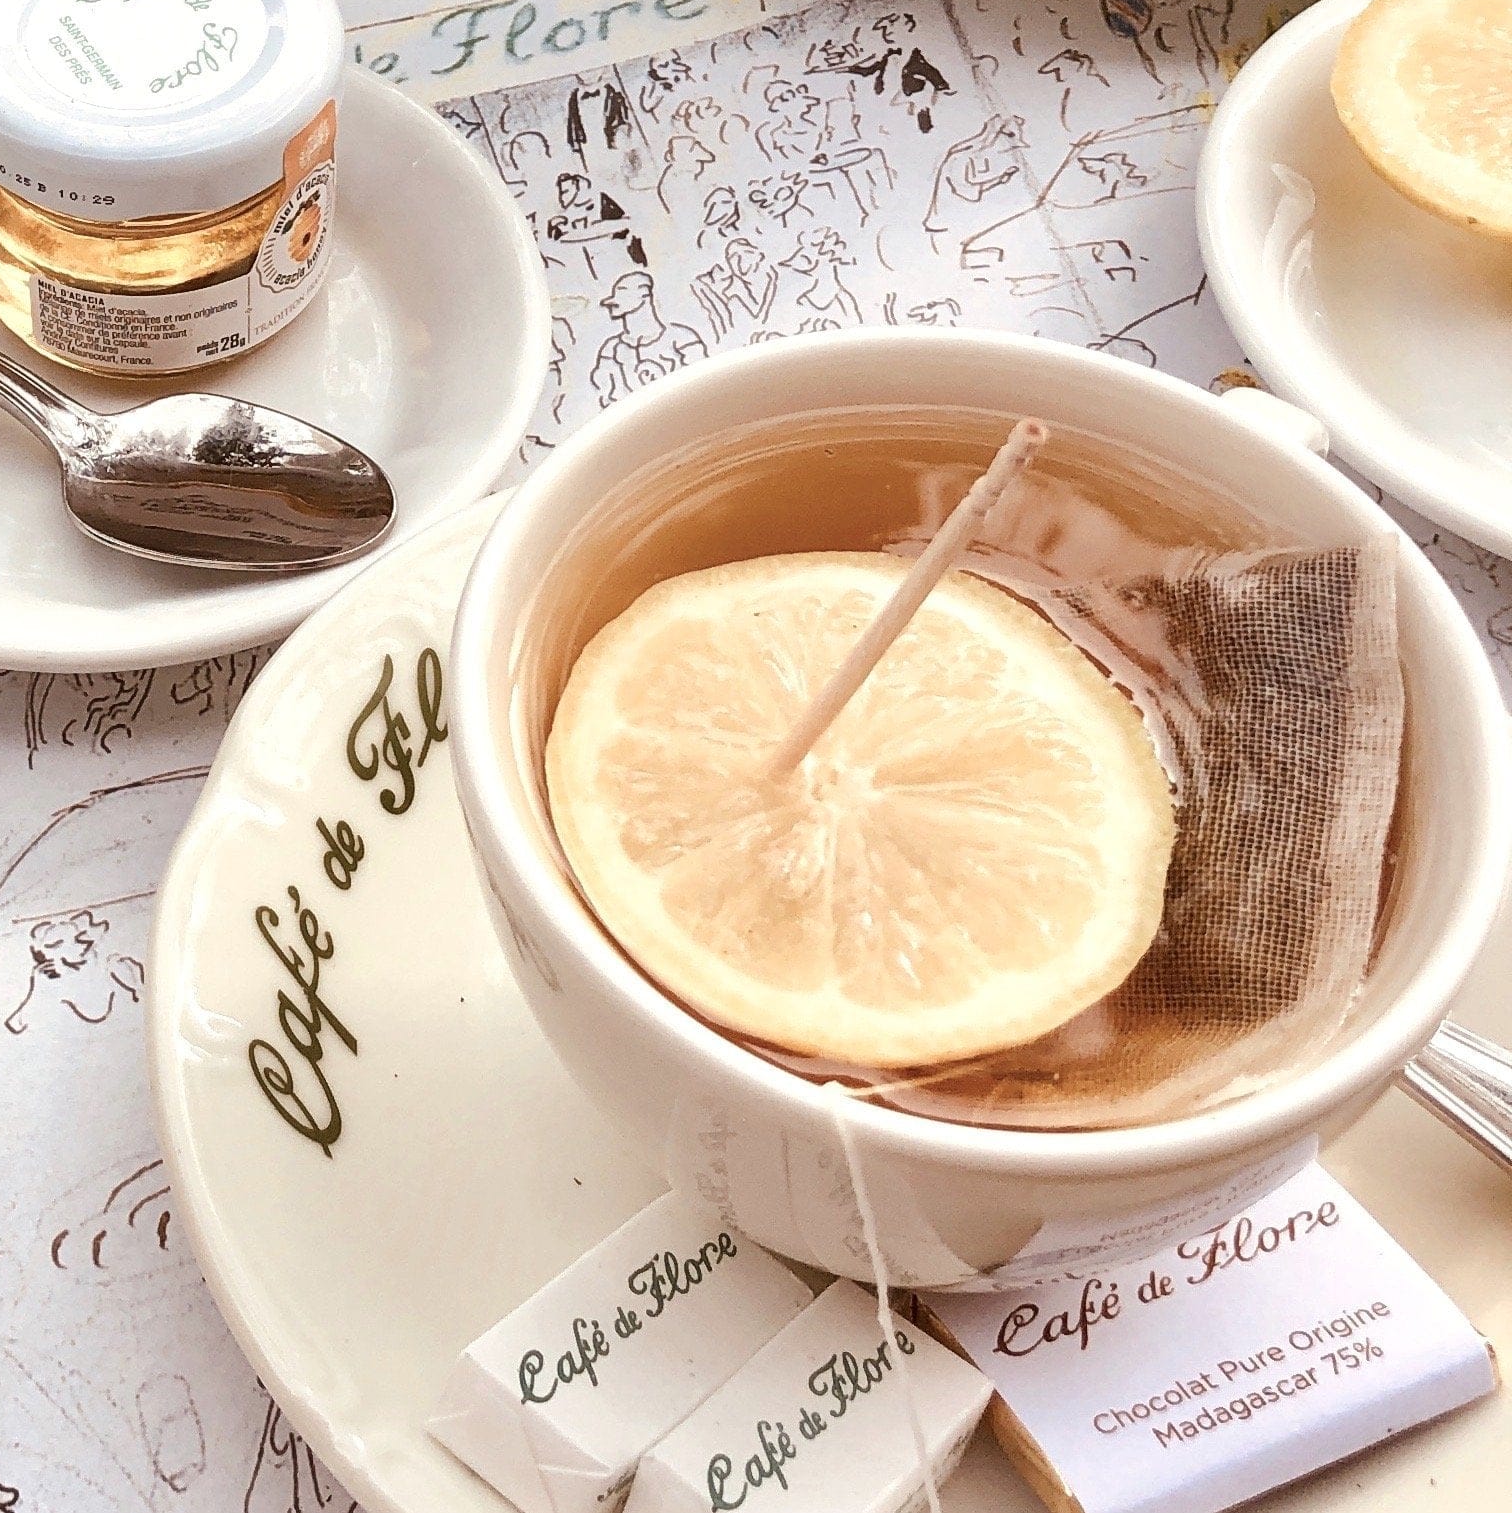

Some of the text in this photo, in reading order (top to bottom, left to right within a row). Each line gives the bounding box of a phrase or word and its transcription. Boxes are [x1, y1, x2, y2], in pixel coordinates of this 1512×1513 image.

[48, 35, 71, 58] DES
[149, 22, 238, 93] Flore
[38, 279, 105, 306] MIEL D'ACACIA
[193, 299, 238, 319] originaires
[220, 333, 246, 352] 28g
[247, 884, 359, 1159] Café
[315, 818, 366, 891] de
[519, 1229, 738, 1406] Café de Flore
[992, 1277, 1120, 1358] Café
[1137, 1269, 1175, 1305] de
[1177, 1200, 1340, 1286] Flore
[706, 1328, 917, 1513] Café de Flore
[1092, 1297, 1393, 1438] Chocolat Pure Origine
[1151, 1337, 1386, 1450] Madagascar 75%
